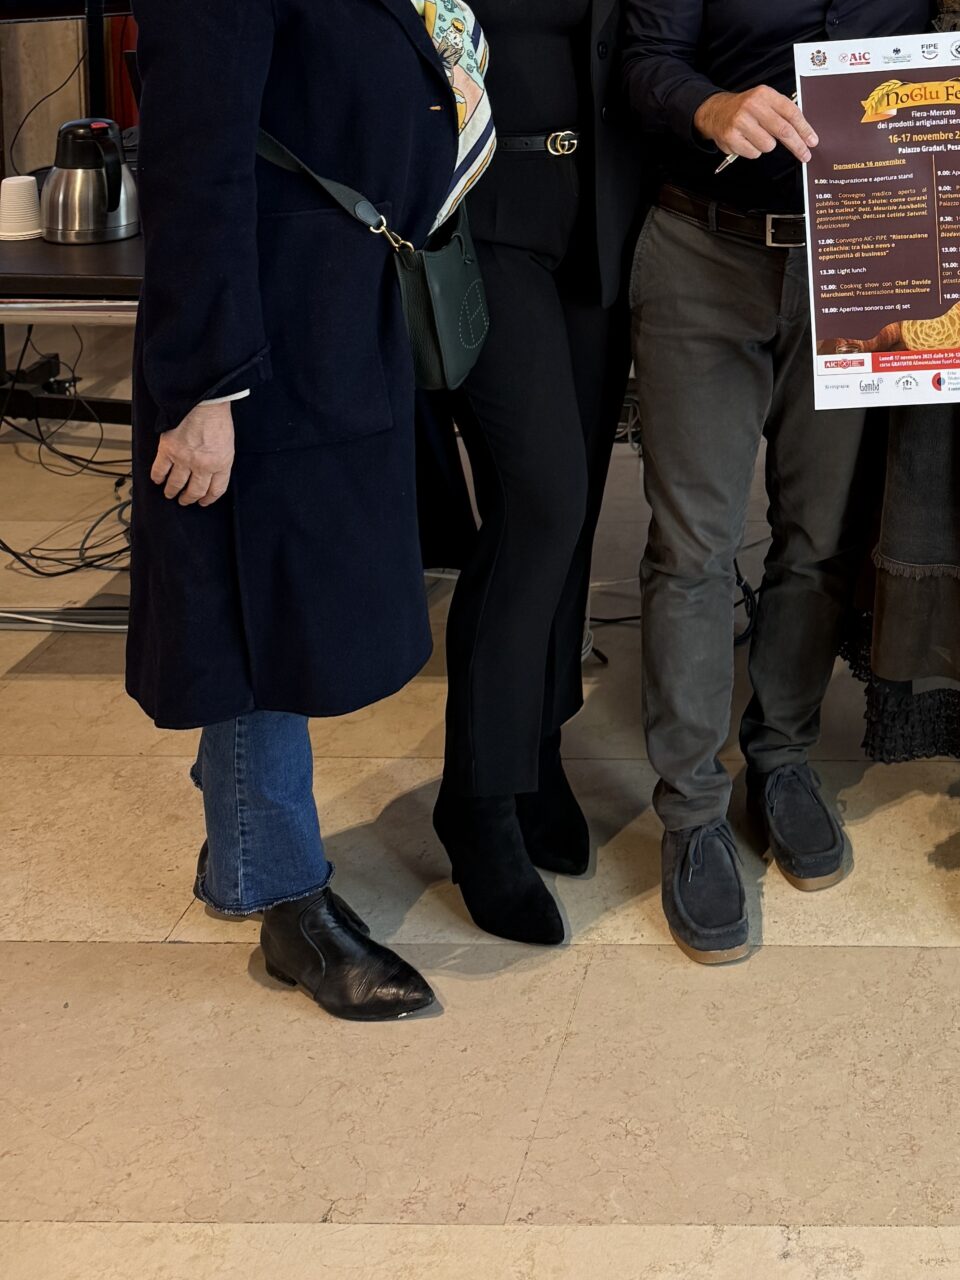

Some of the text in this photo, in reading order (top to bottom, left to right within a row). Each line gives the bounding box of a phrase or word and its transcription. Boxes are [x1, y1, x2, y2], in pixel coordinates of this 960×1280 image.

[850, 52, 870, 62] AiC
[886, 88, 940, 106] NoGlu
[912, 110, 956, 118] Fiera-Mercato
[888, 121, 914, 130] prodotti
[916, 118, 948, 127] artigianali
[888, 134, 910, 144] 16-17
[912, 132, 953, 142] novembre
[898, 146, 920, 154] Palazzo
